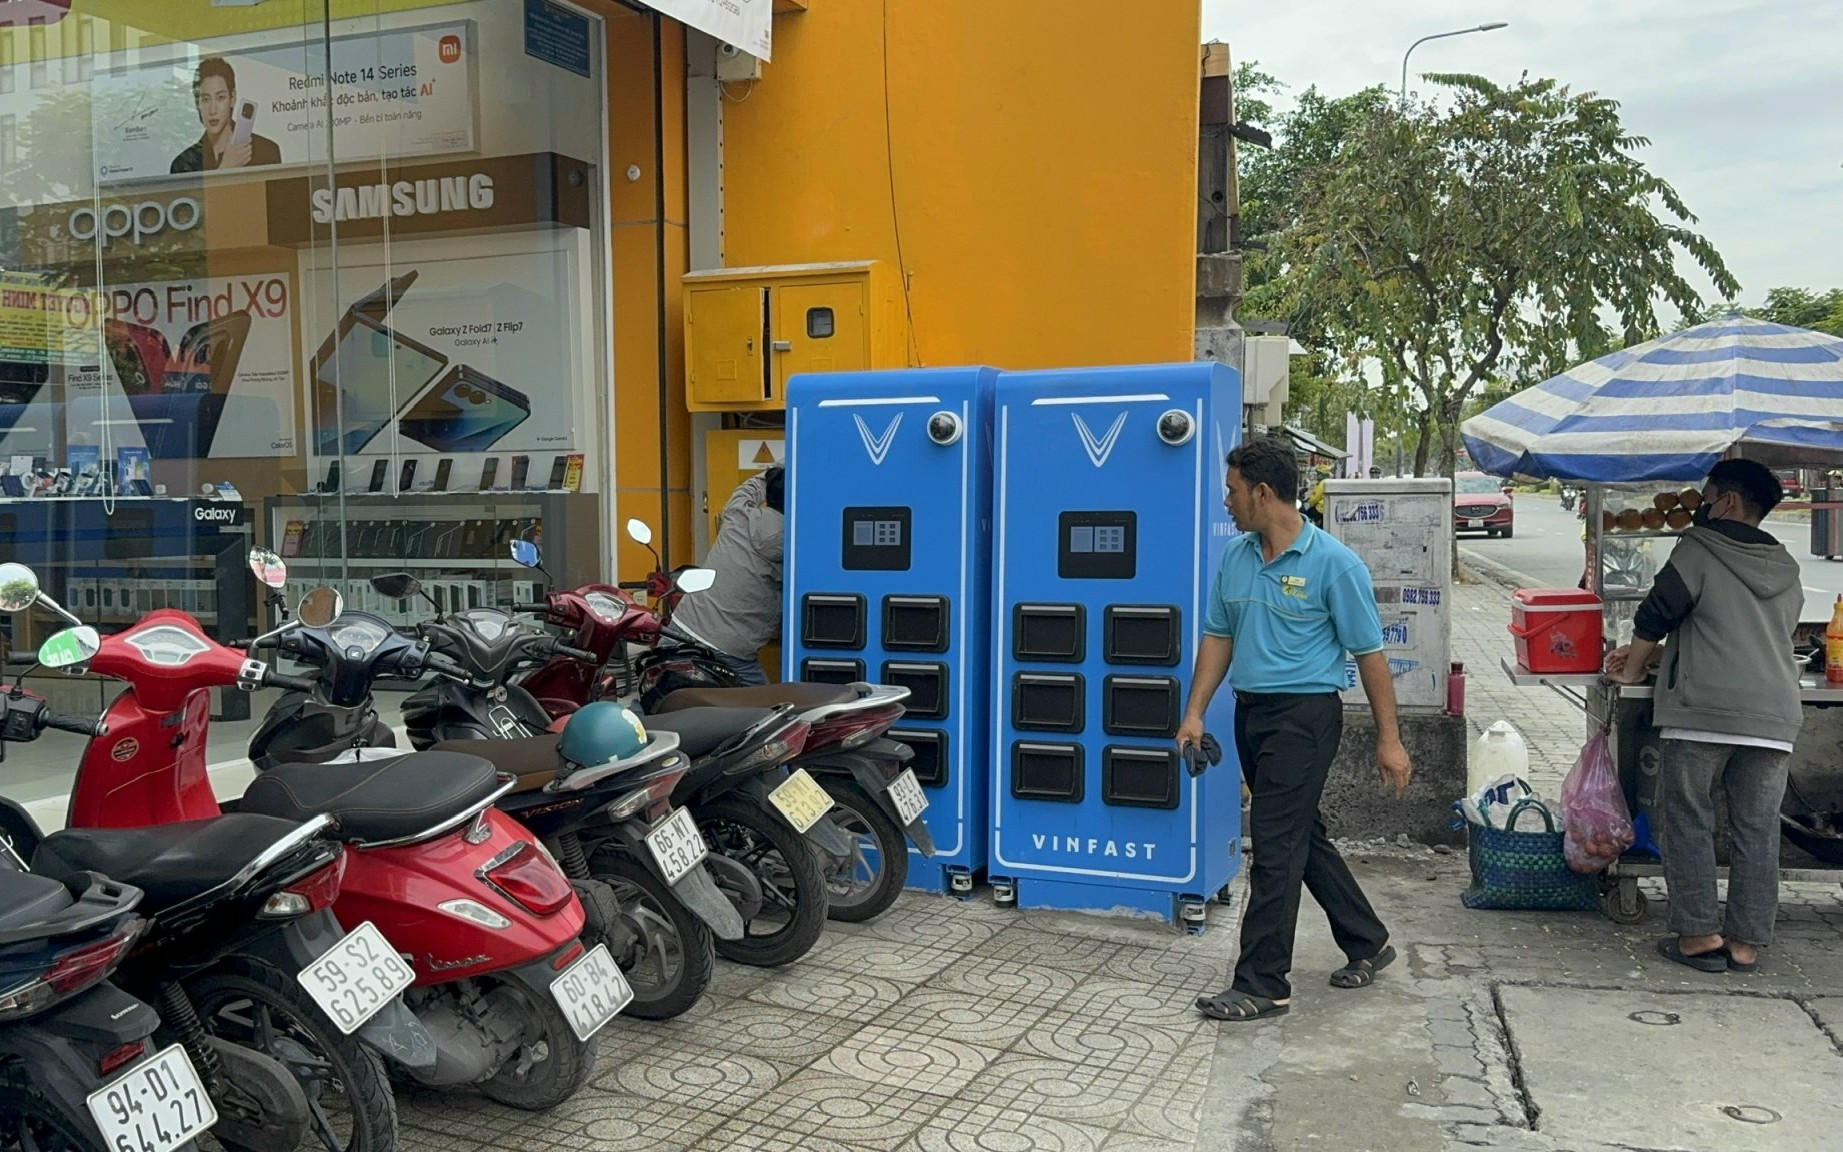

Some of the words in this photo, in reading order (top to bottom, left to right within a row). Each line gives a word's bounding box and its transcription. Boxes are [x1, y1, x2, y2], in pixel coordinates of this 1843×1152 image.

[289, 74, 325, 90] Redmi
[360, 67, 375, 81] 14
[379, 64, 417, 80] Series
[336, 93, 354, 108] độc
[381, 88, 399, 101] tạo
[401, 85, 417, 98] tác
[68, 197, 201, 247] oppo
[311, 173, 494, 224] SAMSUNG
[65, 287, 159, 329] OPPO
[167, 282, 233, 323] Find
[240, 278, 288, 318] X9
[429, 325, 461, 337] Galaxy
[462, 325, 468, 334] Z
[468, 323, 492, 334] Fold7
[194, 507, 236, 523] Galaxy
[654, 816, 693, 857] 66-N1
[659, 833, 706, 881] 458.22
[1032, 834, 1156, 860] VINFAST
[313, 935, 380, 993] 59-S2
[562, 956, 608, 1004] 60-B4
[330, 956, 408, 1026] 625.89
[106, 1059, 180, 1125] 94-D1
